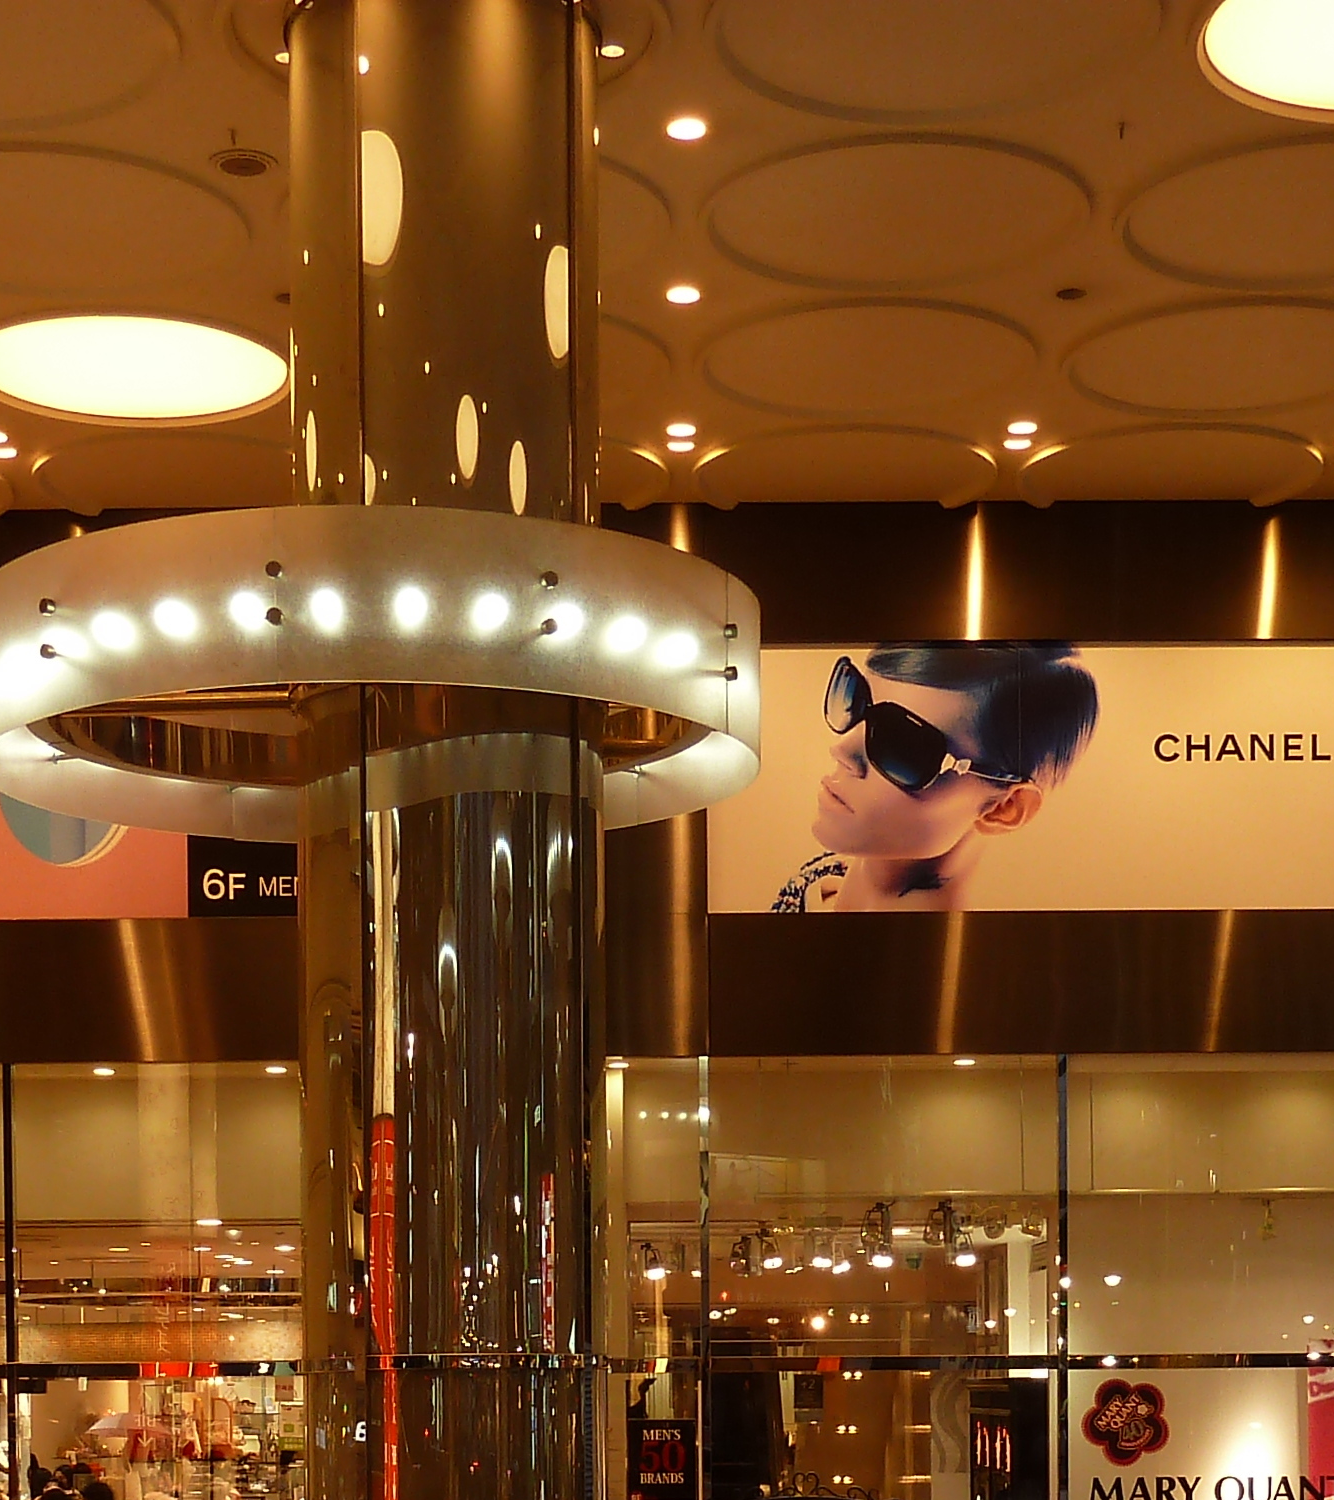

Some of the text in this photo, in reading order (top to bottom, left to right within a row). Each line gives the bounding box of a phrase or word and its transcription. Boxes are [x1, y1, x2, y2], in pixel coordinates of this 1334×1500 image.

[1153, 733, 1332, 762] CHANEL
[202, 868, 246, 900] 6F
[1097, 1396, 1124, 1429] MARY
[1110, 1394, 1142, 1430] QUANT
[643, 1429, 682, 1441] MEN'S
[639, 1441, 686, 1473] 50
[640, 1472, 684, 1484] BRANDS
